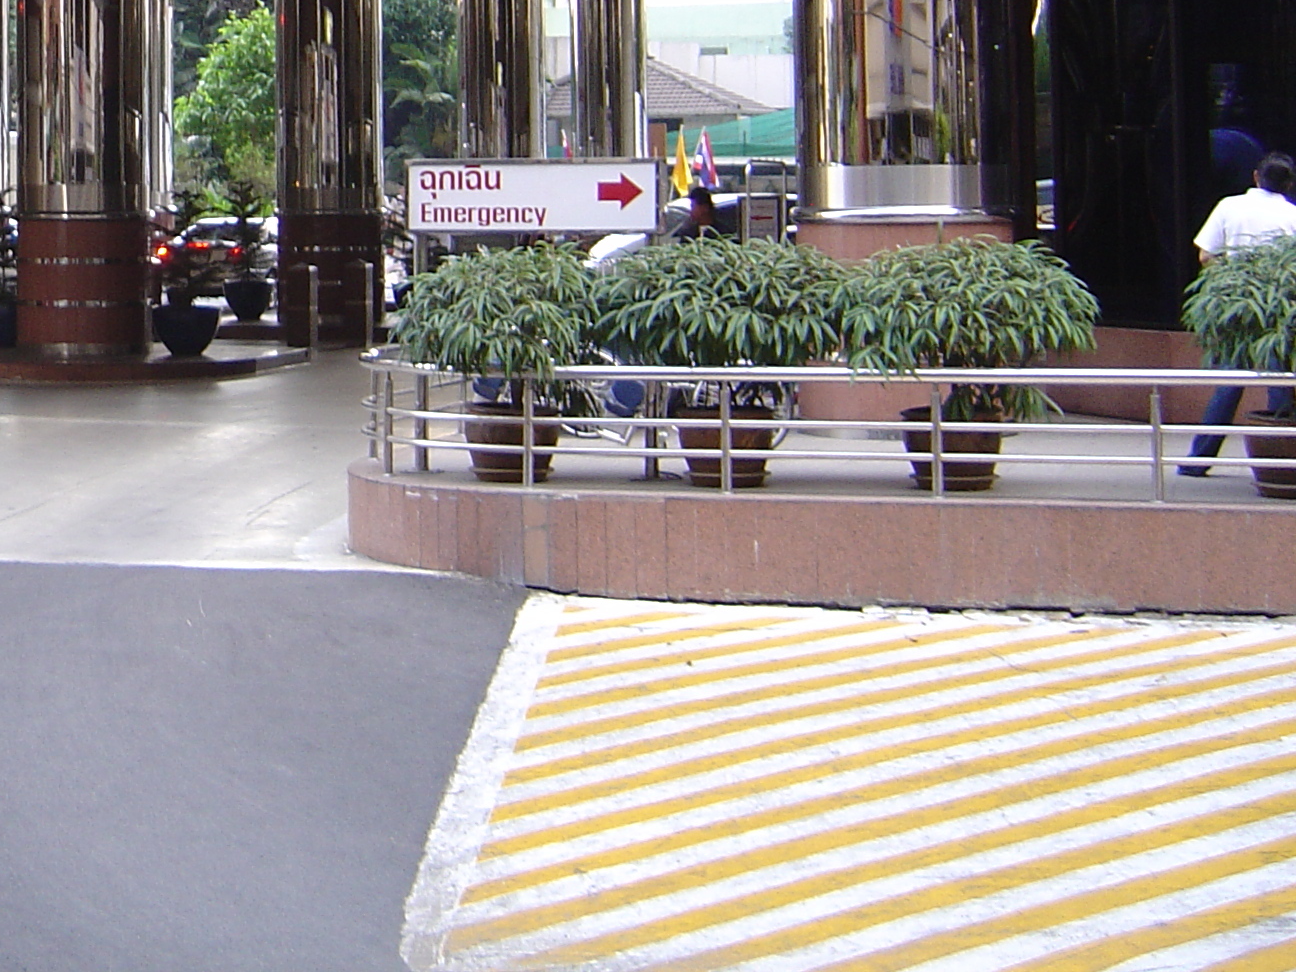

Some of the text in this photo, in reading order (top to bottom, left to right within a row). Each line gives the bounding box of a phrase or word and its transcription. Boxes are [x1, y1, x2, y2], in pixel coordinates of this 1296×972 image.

[419, 164, 501, 200] ฉุกเฉิน
[420, 202, 546, 226] Emergency
